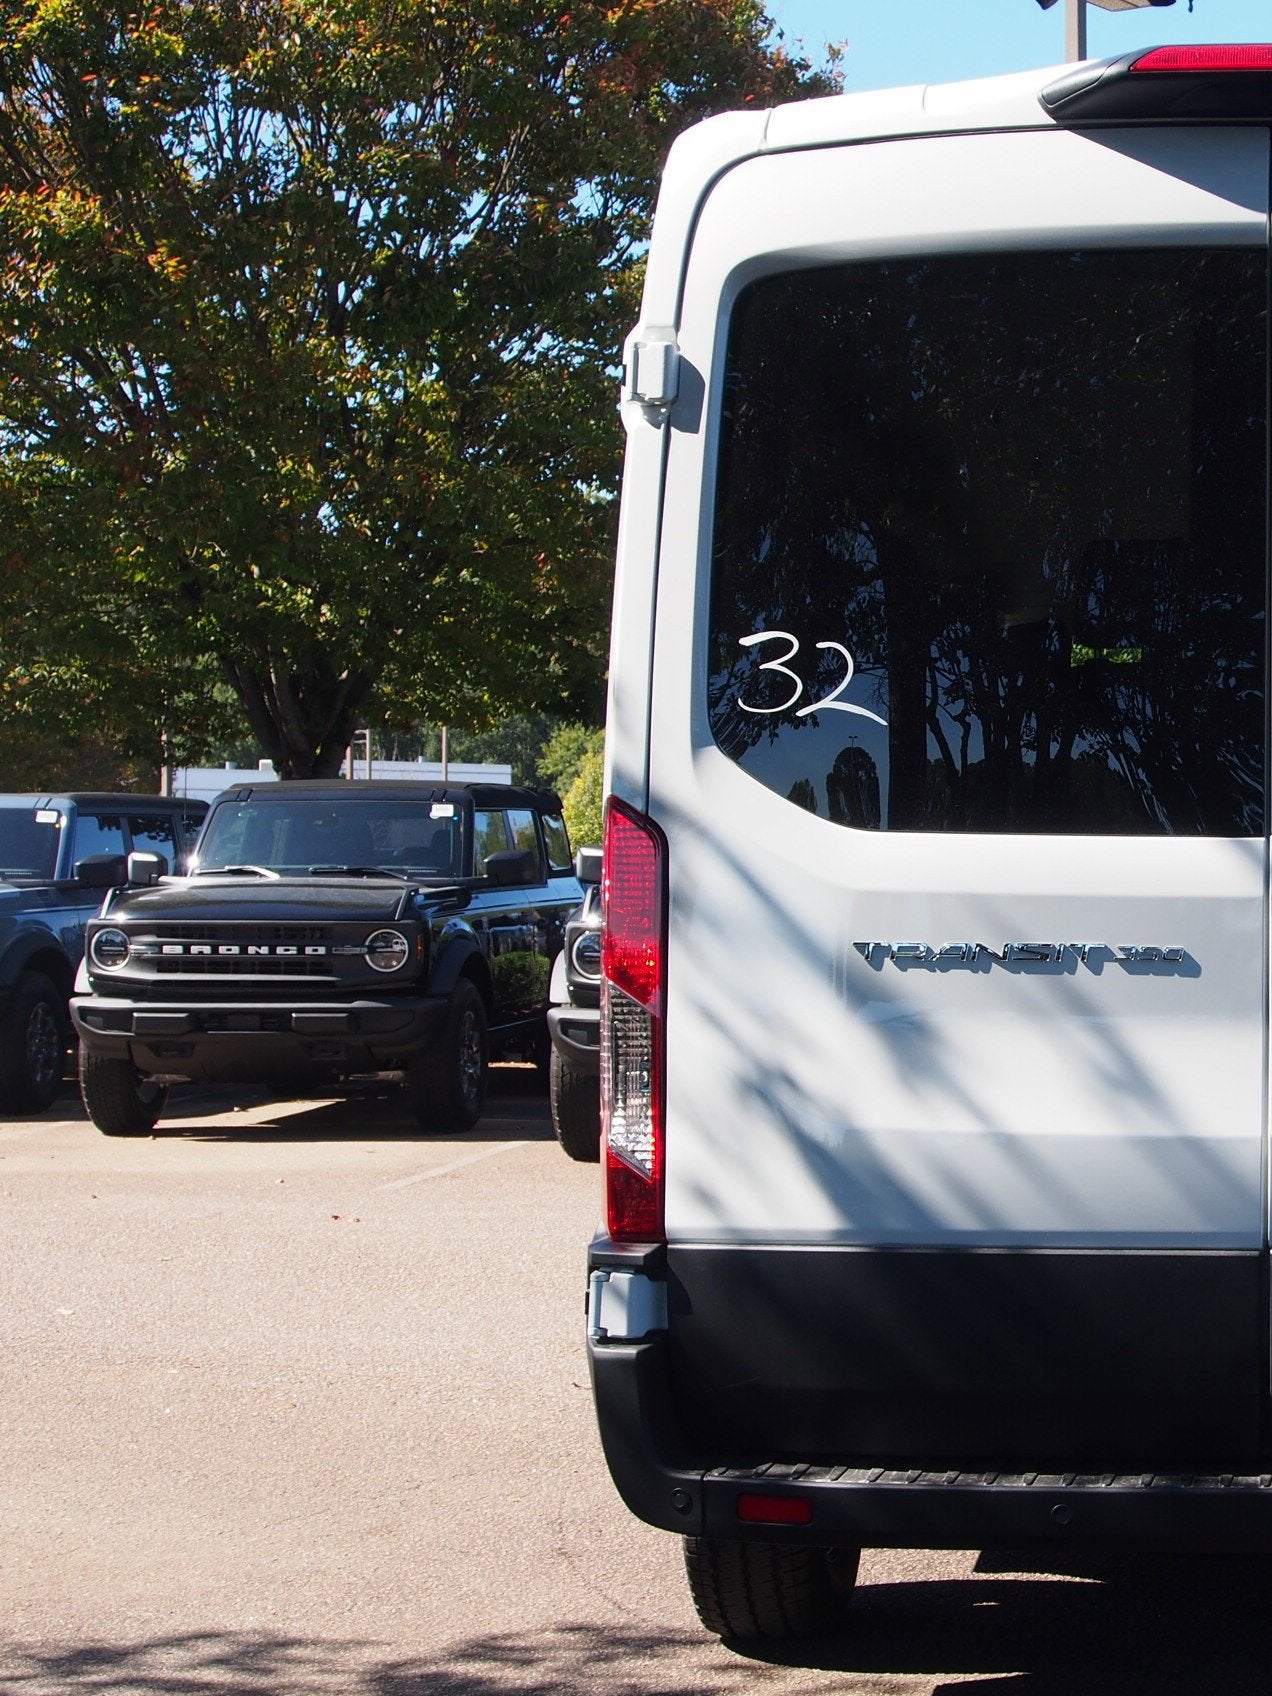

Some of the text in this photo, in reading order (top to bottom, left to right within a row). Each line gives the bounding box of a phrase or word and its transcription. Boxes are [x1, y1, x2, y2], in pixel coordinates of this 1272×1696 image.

[737, 630, 889, 726] 32
[162, 944, 326, 955] BRONCO
[851, 941, 1106, 963] TRANSIT
